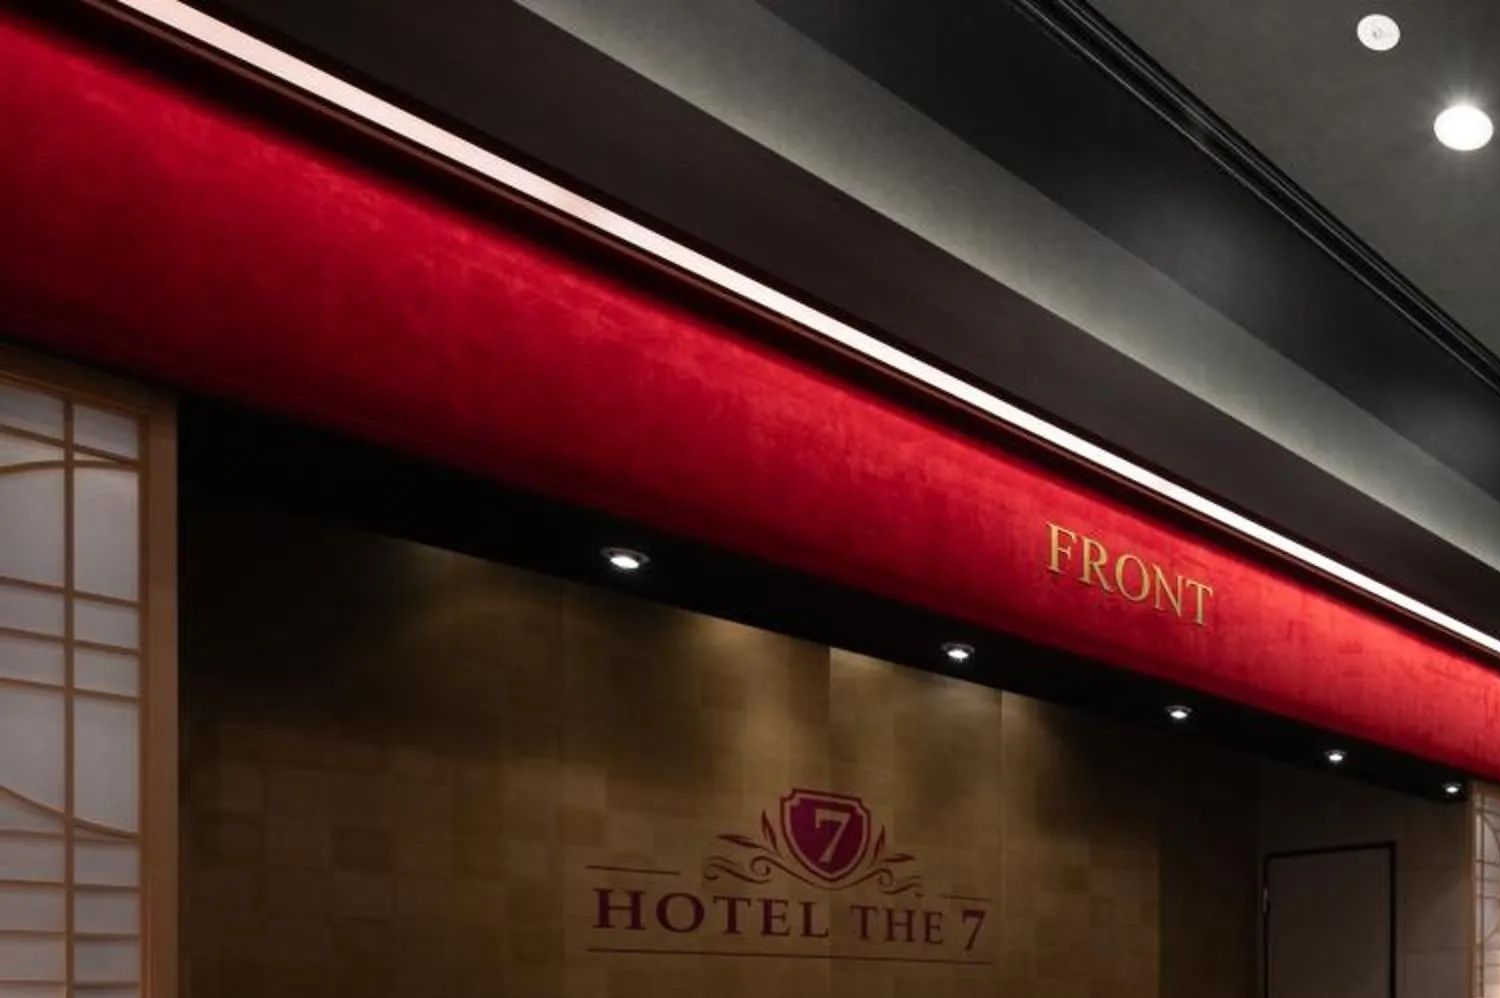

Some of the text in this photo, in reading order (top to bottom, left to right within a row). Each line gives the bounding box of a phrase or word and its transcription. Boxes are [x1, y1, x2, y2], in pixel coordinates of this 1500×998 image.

[1046, 521, 1213, 627] FRONT
[814, 808, 851, 864] 7
[592, 887, 987, 952] HOTEL THE 7
